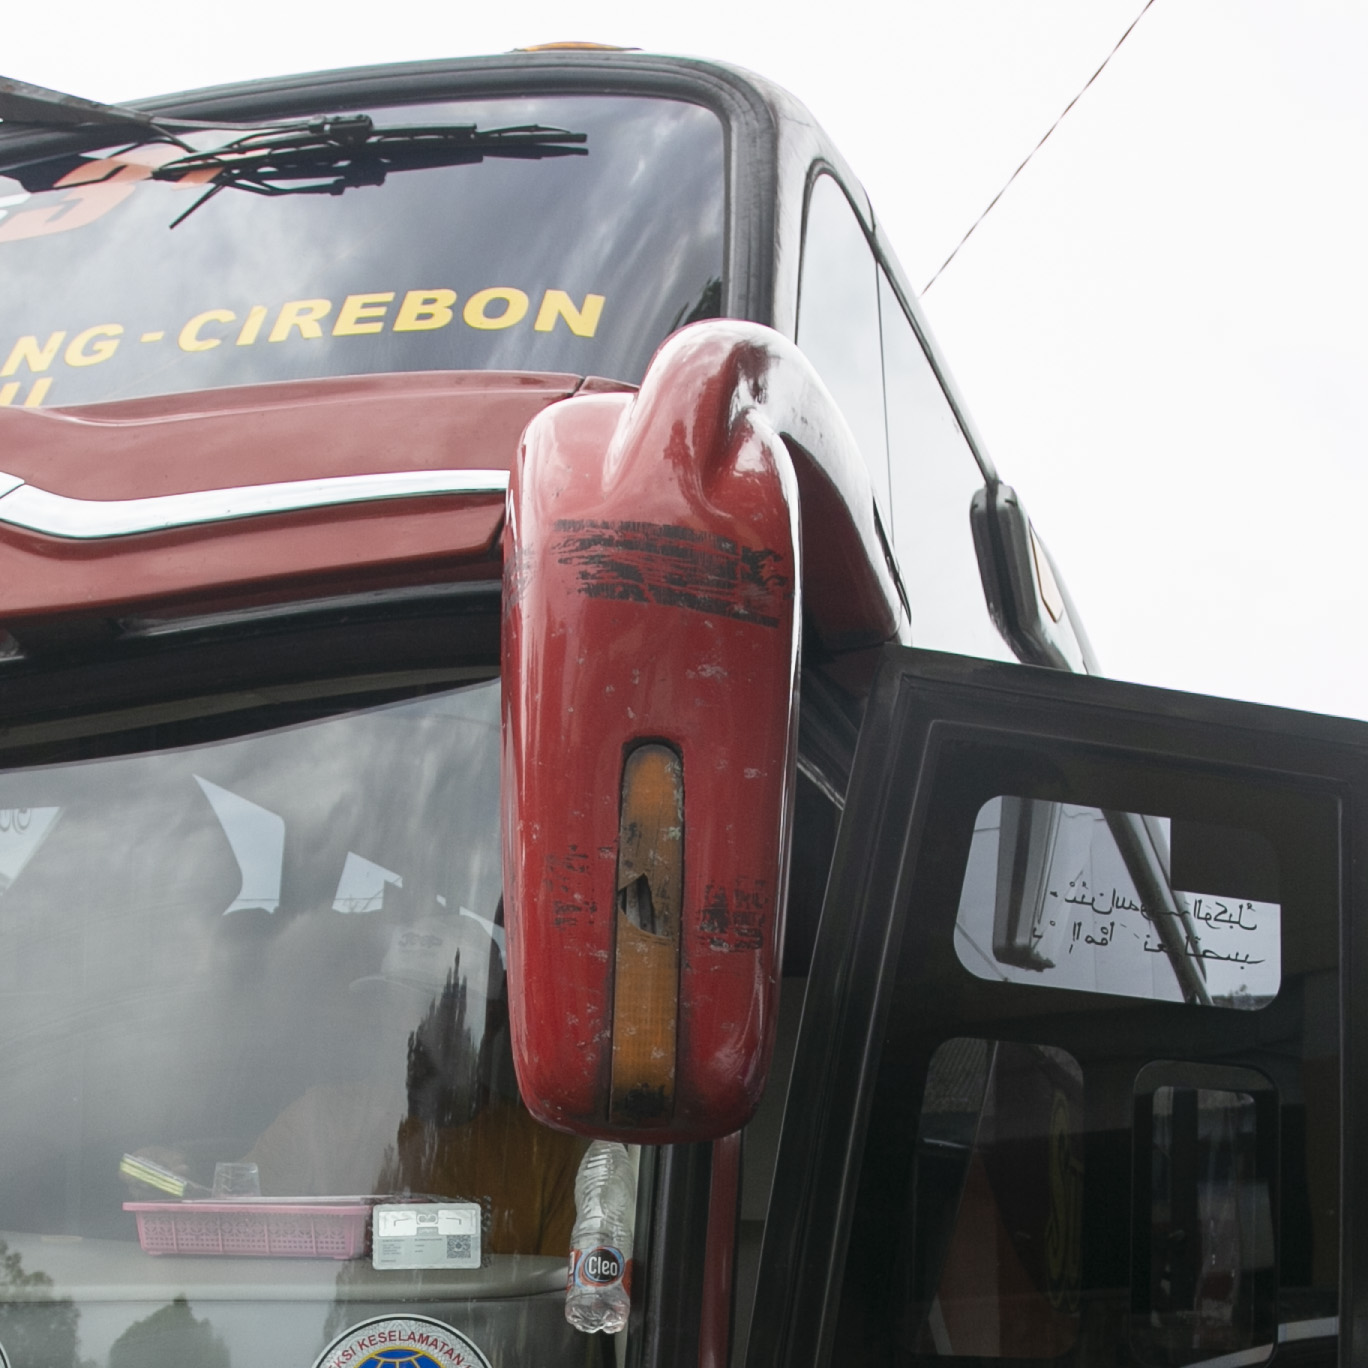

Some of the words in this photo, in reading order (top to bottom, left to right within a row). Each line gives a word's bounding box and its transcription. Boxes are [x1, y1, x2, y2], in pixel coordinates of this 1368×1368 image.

[176, 286, 607, 353] CIREBON
[588, 1256, 618, 1276] Cleo
[357, 1330, 465, 1366] KESELAMATAN
